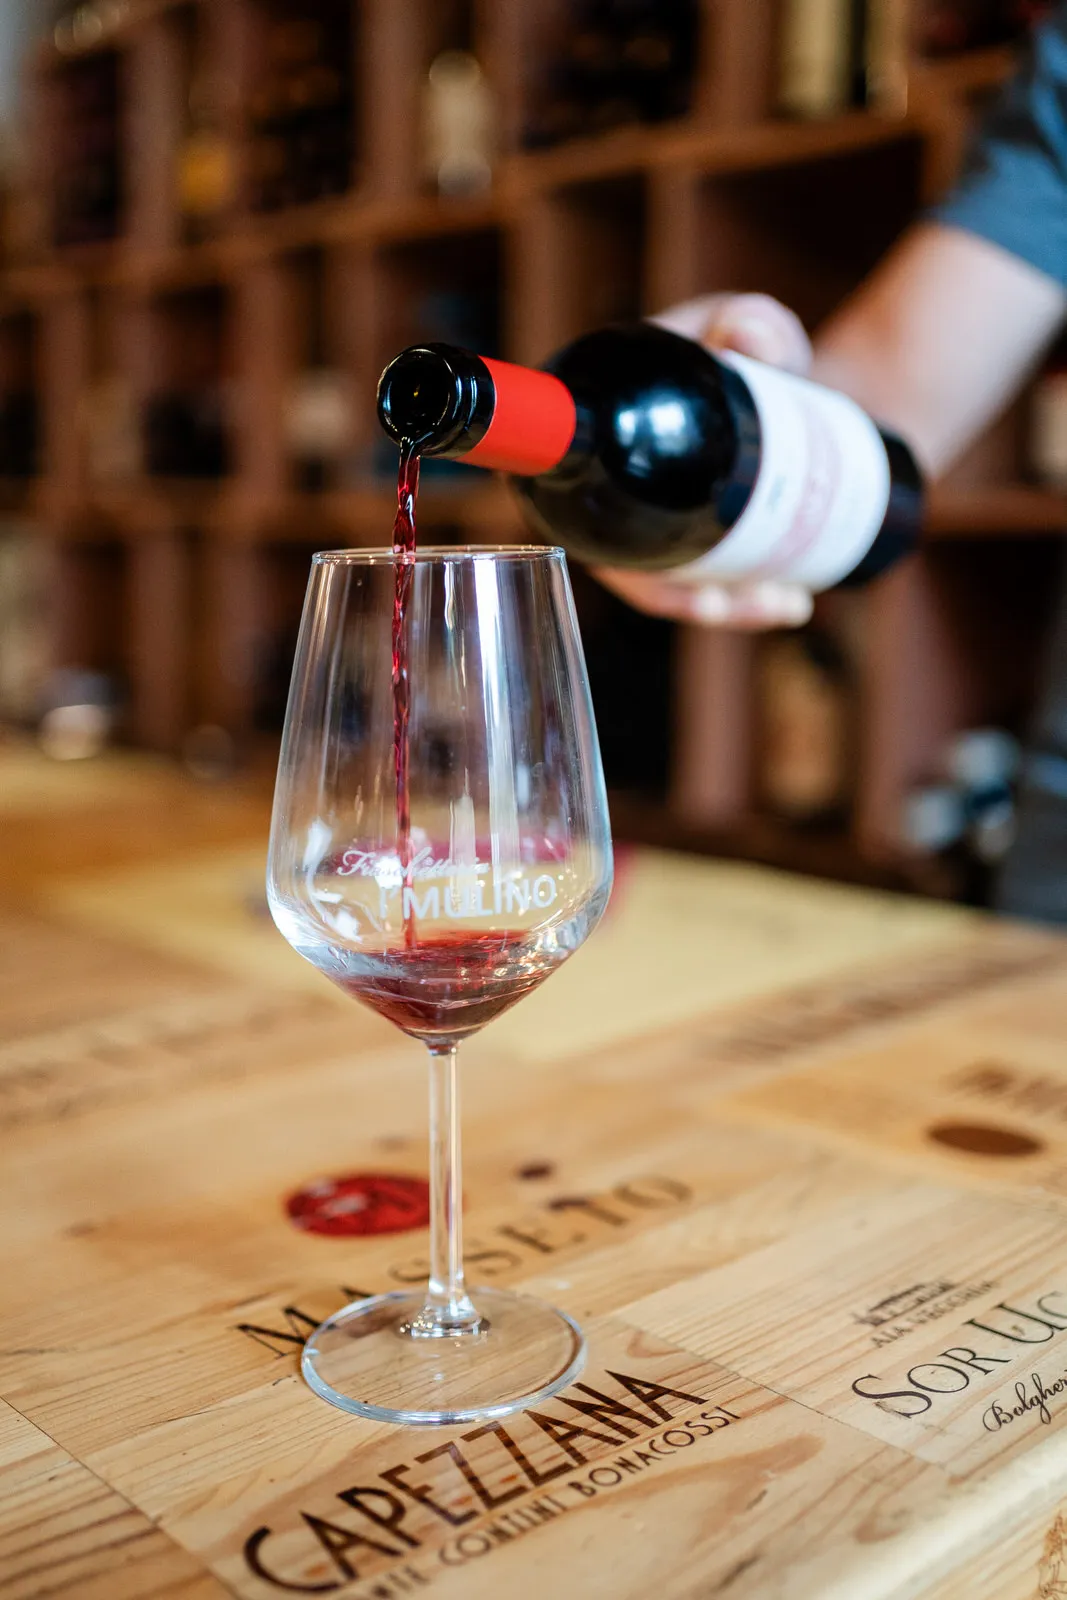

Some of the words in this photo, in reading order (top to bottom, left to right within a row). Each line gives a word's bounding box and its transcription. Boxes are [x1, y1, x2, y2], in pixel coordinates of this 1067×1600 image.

[235, 1174, 693, 1360] MSSETO
[567, 1405, 741, 1498] BONACOSSI
[851, 1347, 1012, 1419] SOR
[243, 1369, 709, 1593] CAPEZZANA
